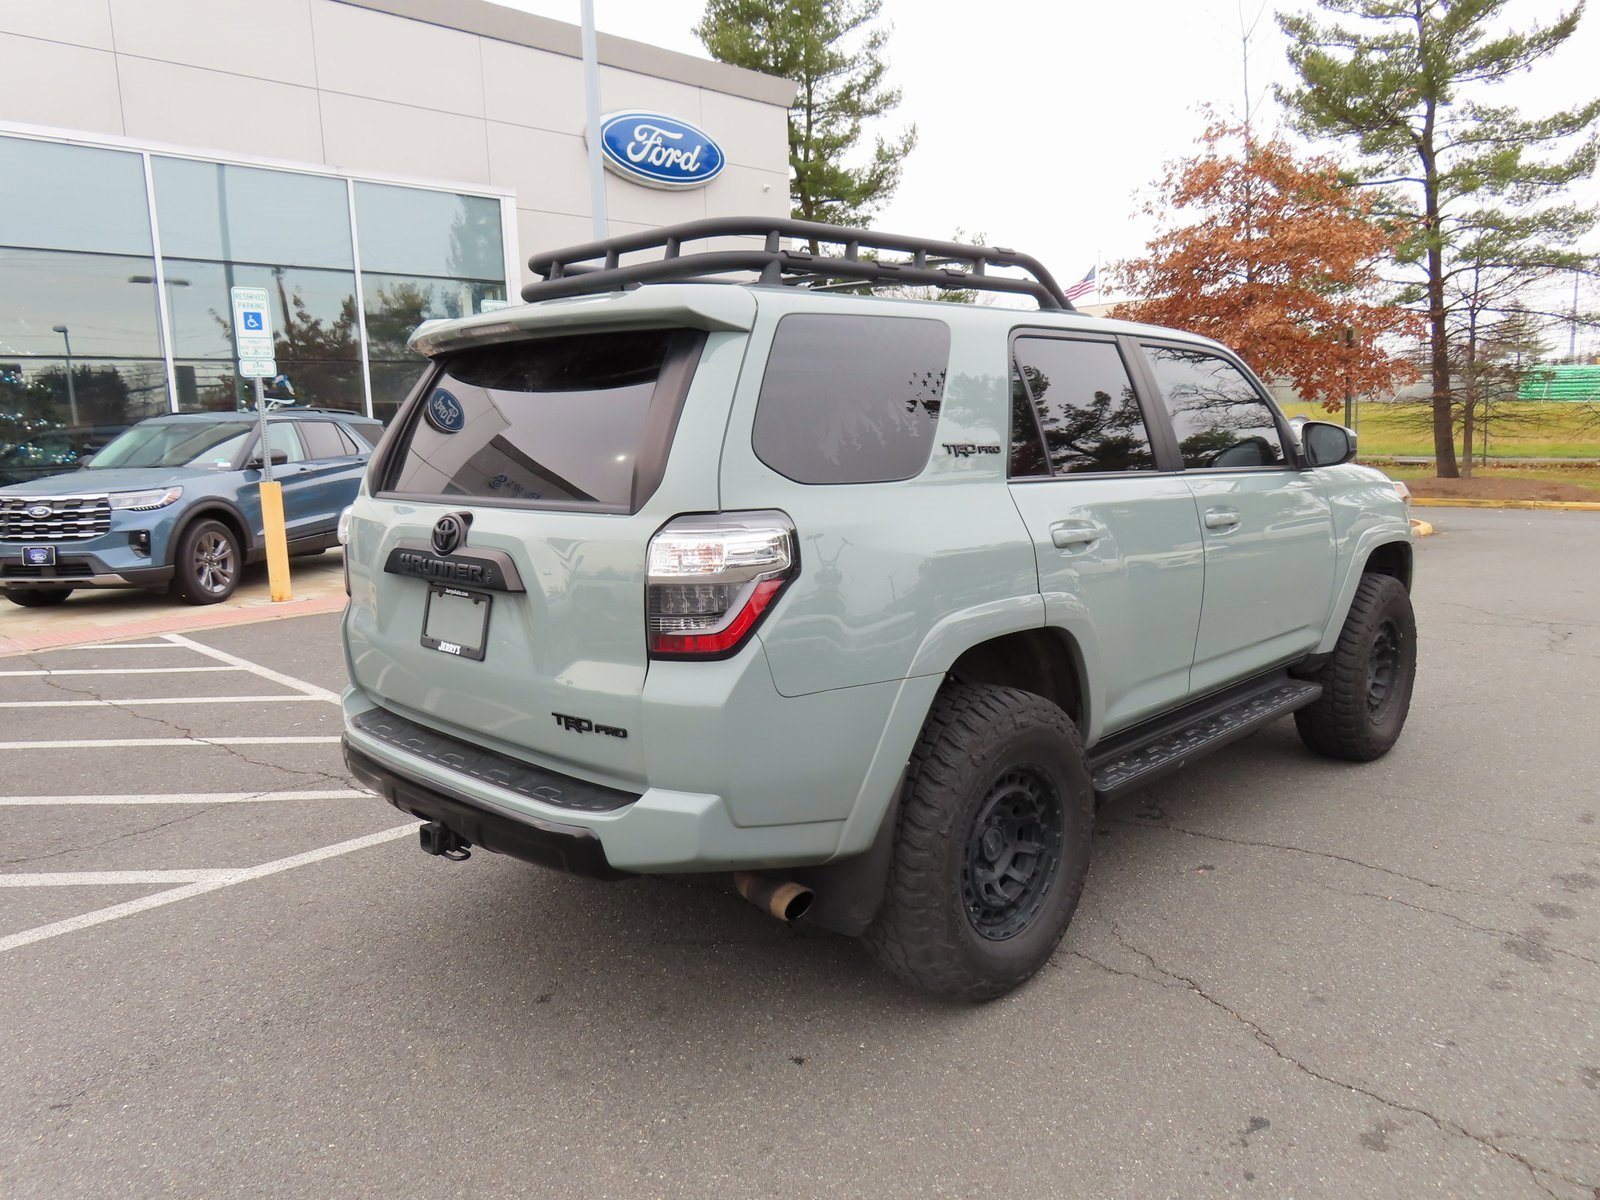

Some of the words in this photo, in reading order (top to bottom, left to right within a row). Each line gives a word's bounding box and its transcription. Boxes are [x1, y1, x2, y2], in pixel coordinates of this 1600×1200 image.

[626, 124, 701, 172] Ford
[234, 292, 266, 301] RESERVED
[237, 302, 265, 310] PARKING
[942, 443, 977, 458] TRD
[977, 445, 1001, 454] PRO
[551, 712, 593, 734] TRD
[594, 723, 628, 738] PRO
